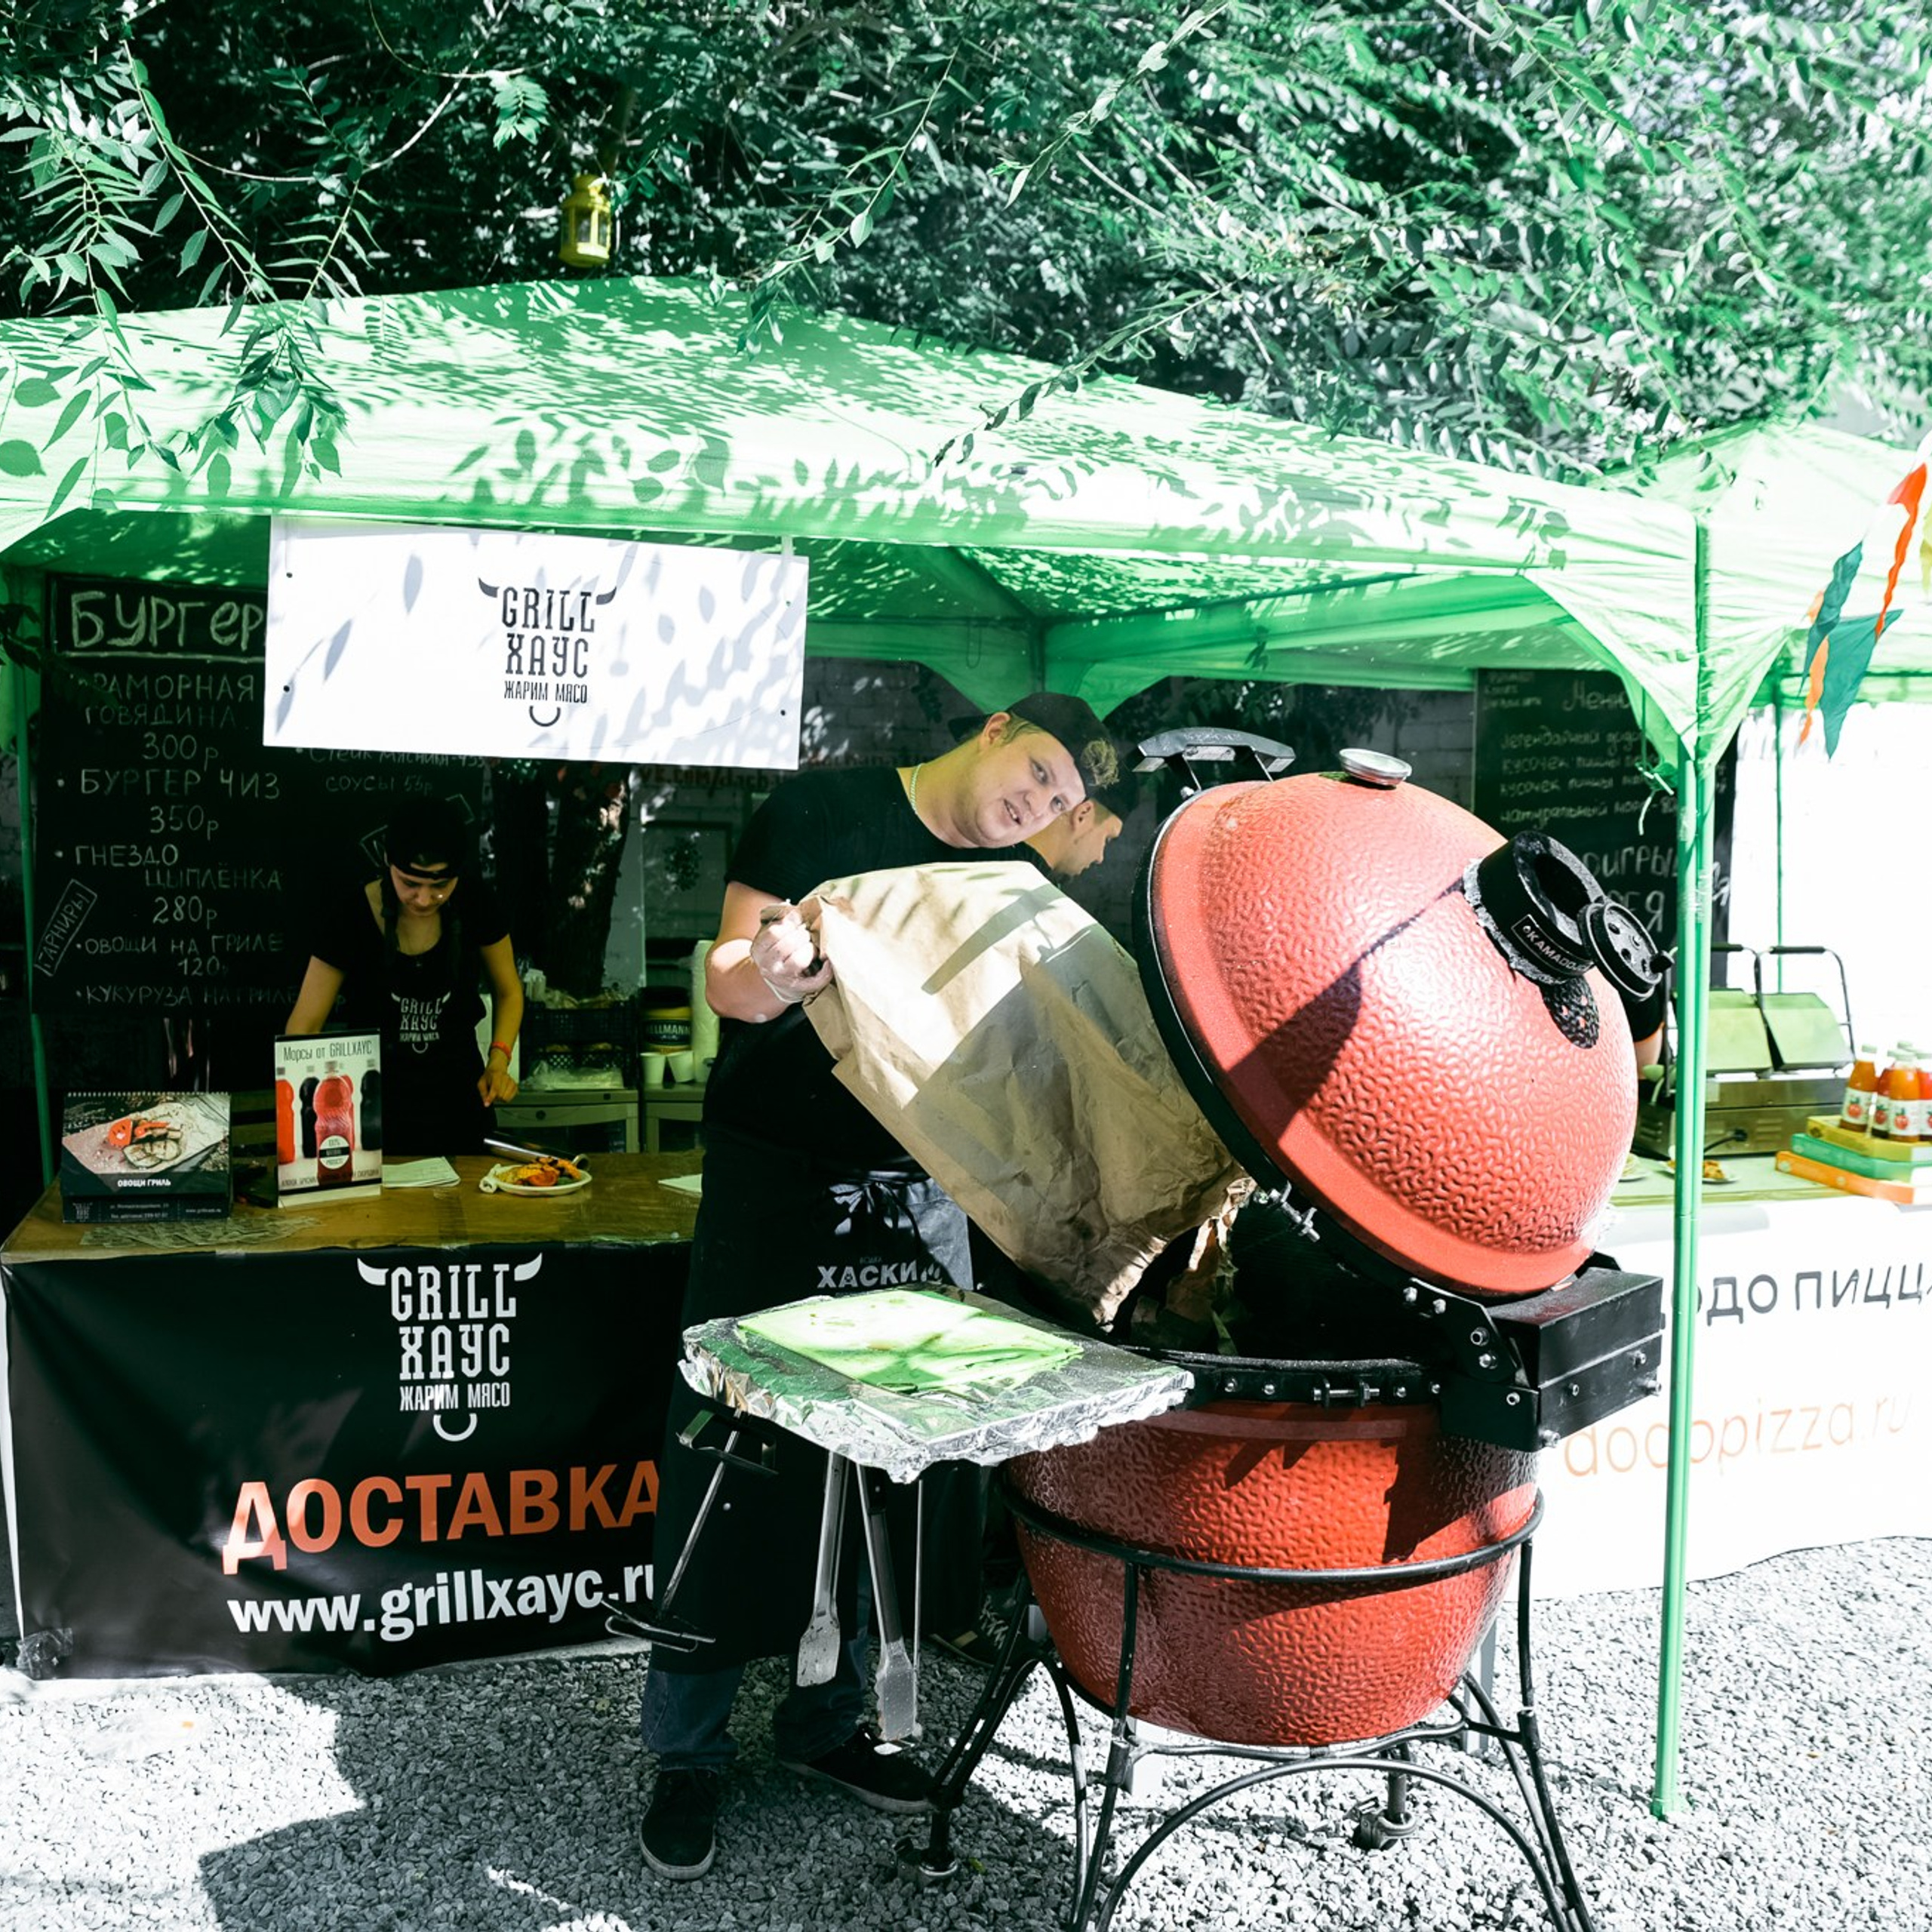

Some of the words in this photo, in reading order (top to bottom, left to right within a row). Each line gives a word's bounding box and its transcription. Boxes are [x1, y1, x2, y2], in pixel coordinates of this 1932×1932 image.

[502, 586, 595, 632] GRILL
[506, 633, 589, 678] ХАУС
[504, 680, 548, 701] ЖАРИМ
[555, 682, 587, 703] МЯСО
[81, 768, 202, 796] БУРГЕР
[220, 768, 281, 800] ЧИЗ
[75, 843, 180, 868] ГНЕЗДО
[38, 891, 91, 970] ГАРНИРЫ
[85, 935, 157, 955] ОВОЩИ
[170, 937, 201, 955] НА
[211, 932, 285, 953] ГРИЛЕ
[85, 984, 192, 1008] КУКУРУЗА
[401, 998, 442, 1014] GRILL
[284, 1046, 312, 1062] Морсы
[316, 1047, 326, 1058] от
[117, 1179, 146, 1188] ОВОЩИ
[147, 1179, 171, 1187] ГРИЛЬ
[817, 1259, 918, 1288] ХАСКИ
[1795, 1262, 1932, 1310] ПИЦЦ
[390, 1263, 516, 1322] GRILL
[399, 1323, 510, 1381] ХАУС
[399, 1384, 459, 1411] ЖАРИМ
[467, 1382, 511, 1409] МЯСО
[222, 1460, 660, 1575] ДОСТАВКА
